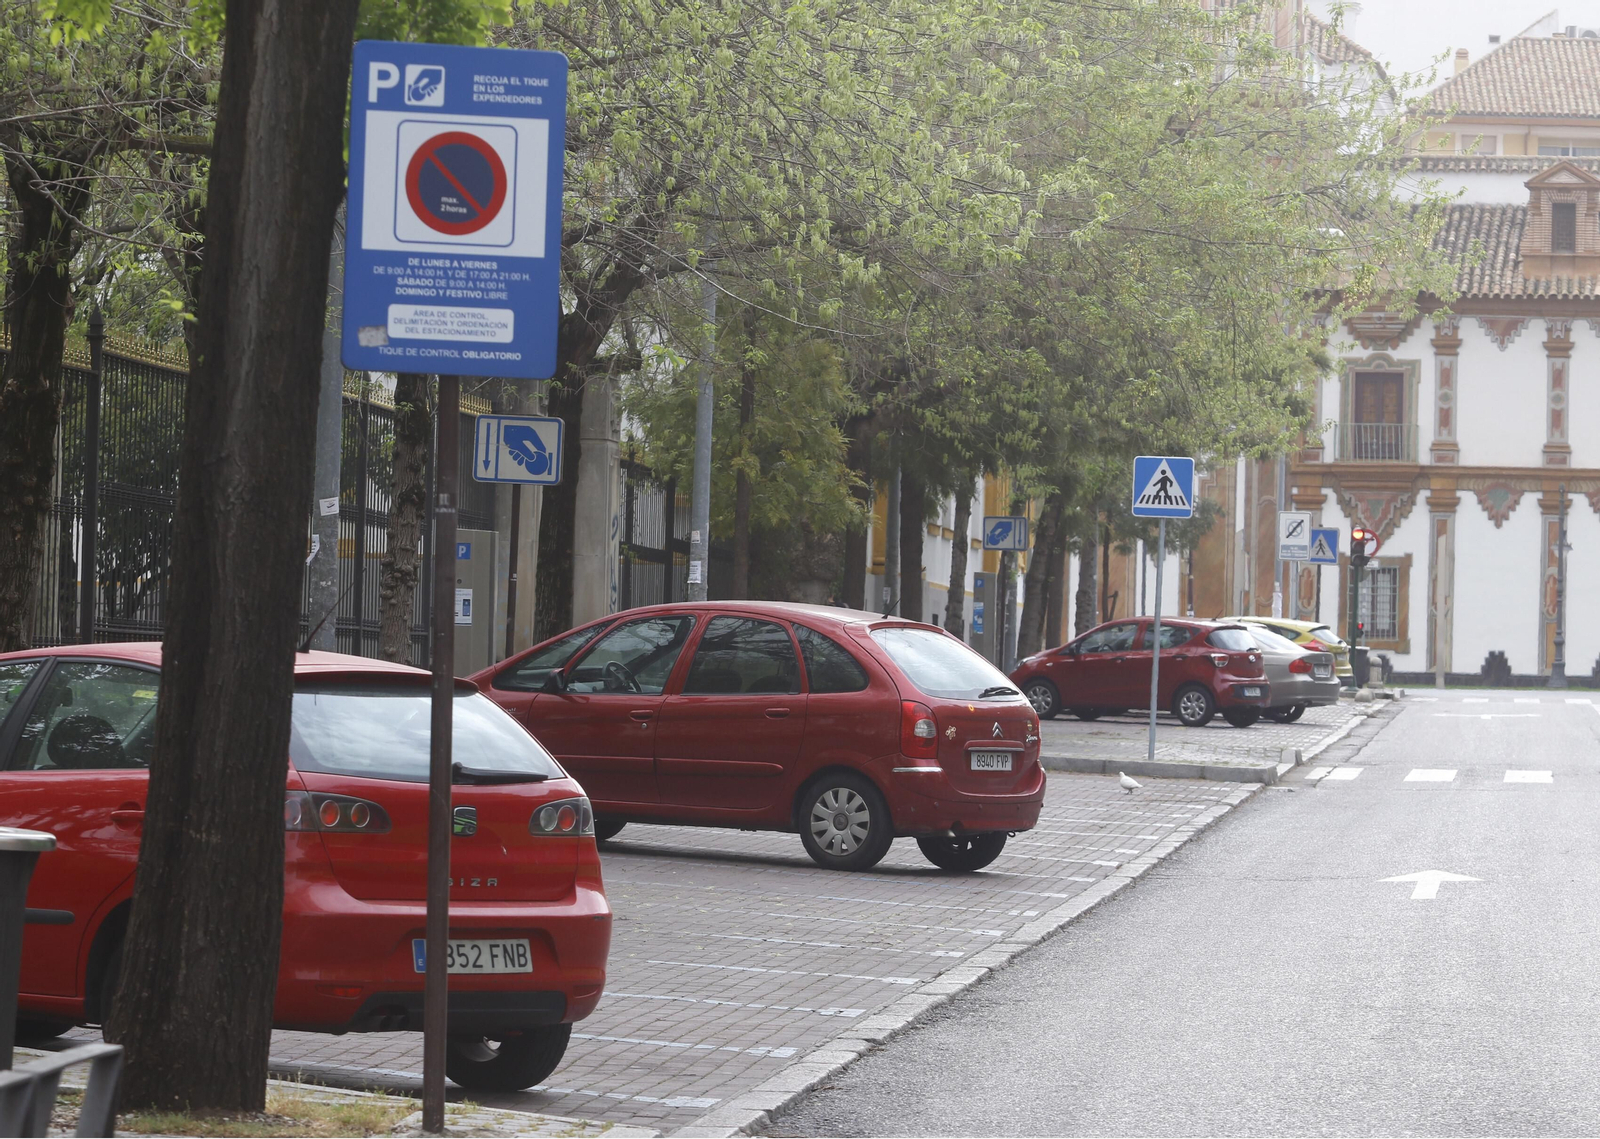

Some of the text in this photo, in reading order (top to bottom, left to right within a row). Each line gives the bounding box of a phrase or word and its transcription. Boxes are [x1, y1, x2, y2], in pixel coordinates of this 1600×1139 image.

[368, 62, 400, 103] P
[474, 75, 548, 87] RECOJA EL TIQUE
[473, 84, 505, 94] EN LOS
[473, 93, 542, 105] EXPENDEDORES
[446, 205, 467, 213] horas
[408, 258, 420, 266] DE
[422, 259, 451, 267] LUNES
[460, 260, 498, 270] VIERNES
[374, 266, 384, 274] DE
[499, 272, 521, 280] 21:00
[397, 276, 434, 286] SÁBADO
[395, 287, 437, 296] DOMINGO
[446, 289, 482, 298] FESTIVO
[484, 291, 507, 300] LIBRE
[422, 327, 496, 337] ESTACIONAMIENTO
[379, 347, 403, 355] TIQUE
[420, 349, 460, 358] CONTROL
[462, 350, 521, 360] OBLIGATORIO
[458, 545, 466, 558] P
[977, 754, 1008, 768] 8940 FVP
[418, 958, 424, 966] E
[489, 944, 528, 968] FNB
